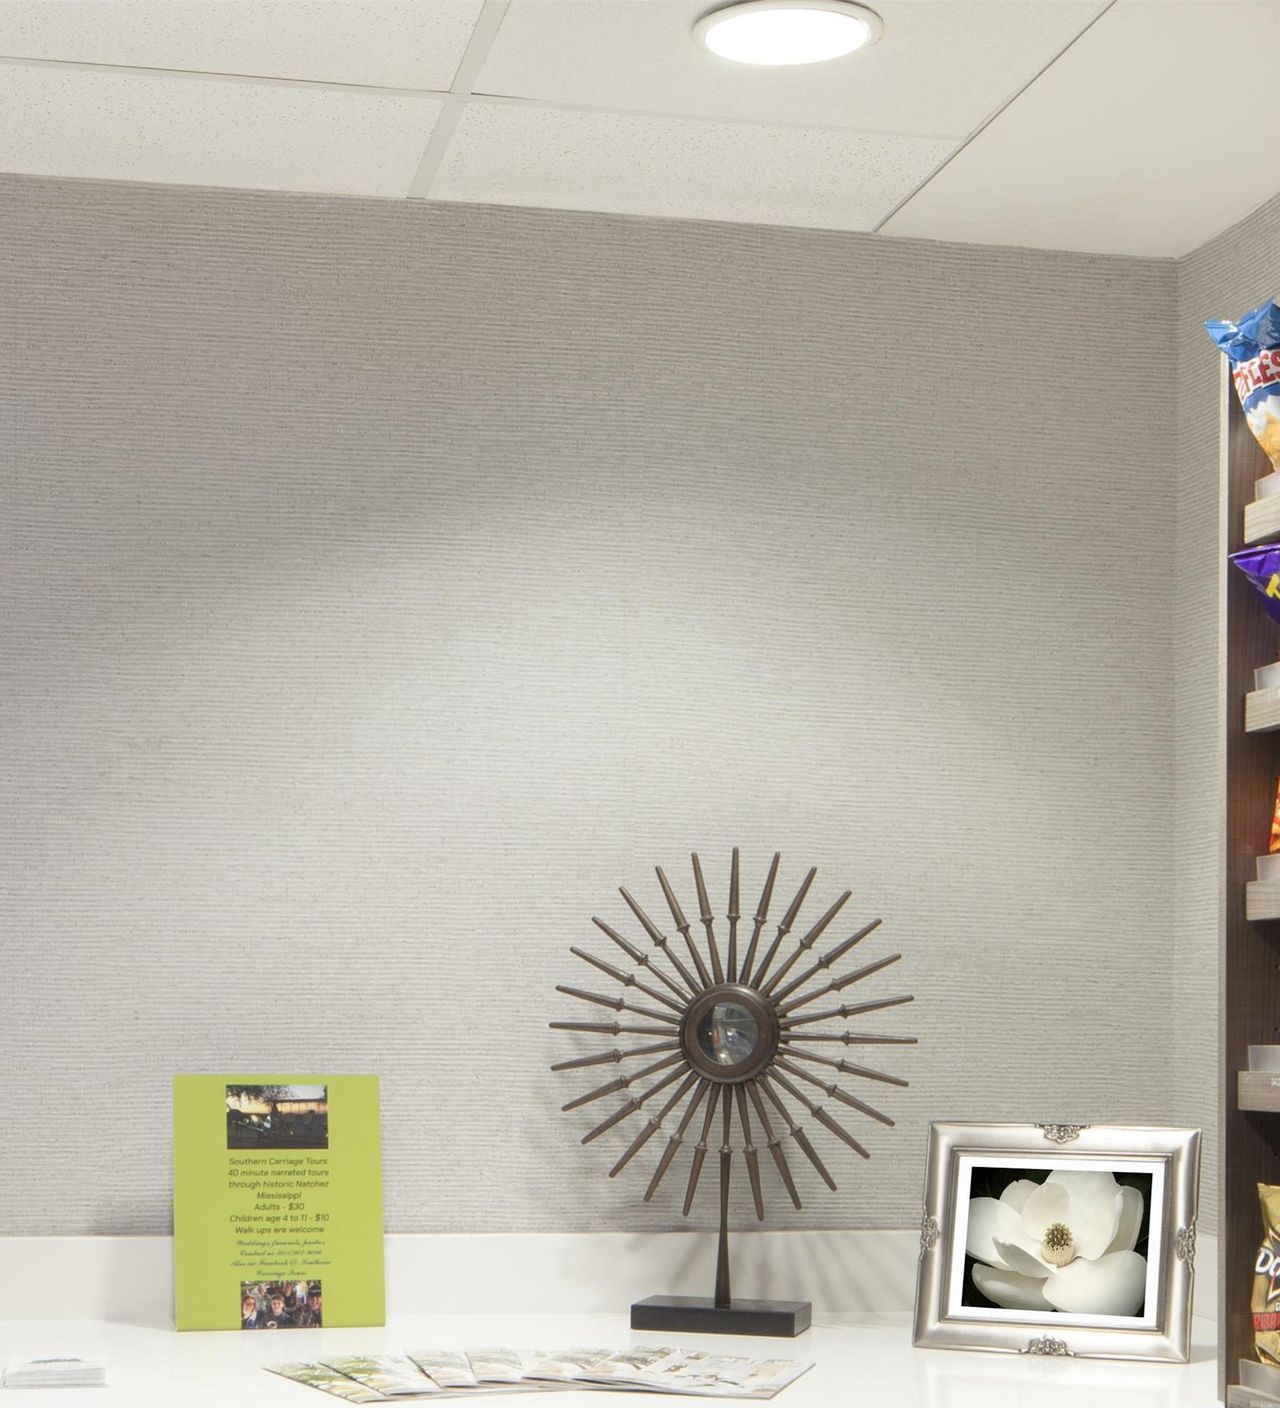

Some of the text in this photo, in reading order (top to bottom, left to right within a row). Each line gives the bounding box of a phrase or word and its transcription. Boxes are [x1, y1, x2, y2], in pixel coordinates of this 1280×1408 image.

[228, 1157, 328, 1167] Southern Carriage Tours
[227, 1169, 329, 1177] 40 minute narrated tours
[228, 1180, 329, 1189] through historic Natchez
[257, 1191, 301, 1200] Mississippi
[254, 1202, 305, 1211] Adults $30
[229, 1214, 264, 1223] Children
[265, 1215, 280, 1223] age
[315, 1213, 330, 1221] $10
[235, 1226, 255, 1234] Walk
[256, 1227, 271, 1235] ups
[289, 1226, 325, 1234] welcome
